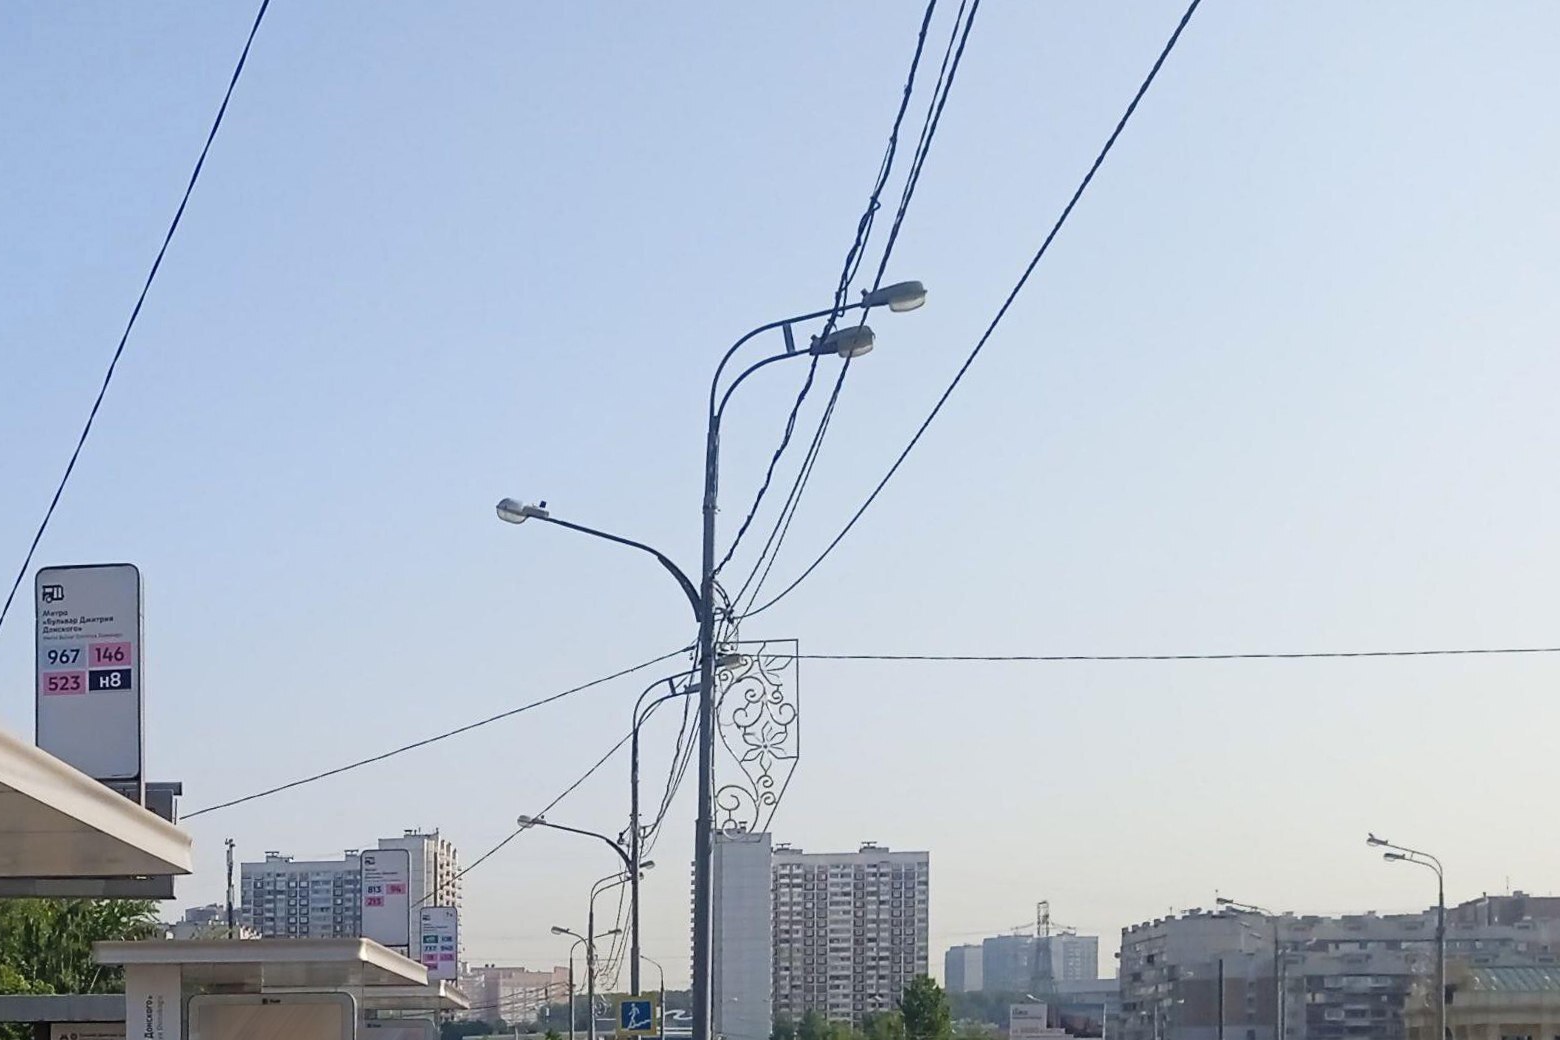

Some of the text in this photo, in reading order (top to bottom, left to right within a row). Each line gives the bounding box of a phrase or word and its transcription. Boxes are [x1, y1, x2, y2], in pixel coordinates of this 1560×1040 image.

[47, 649, 81, 665] 967
[95, 646, 125, 662] 146
[47, 675, 81, 692] 523
